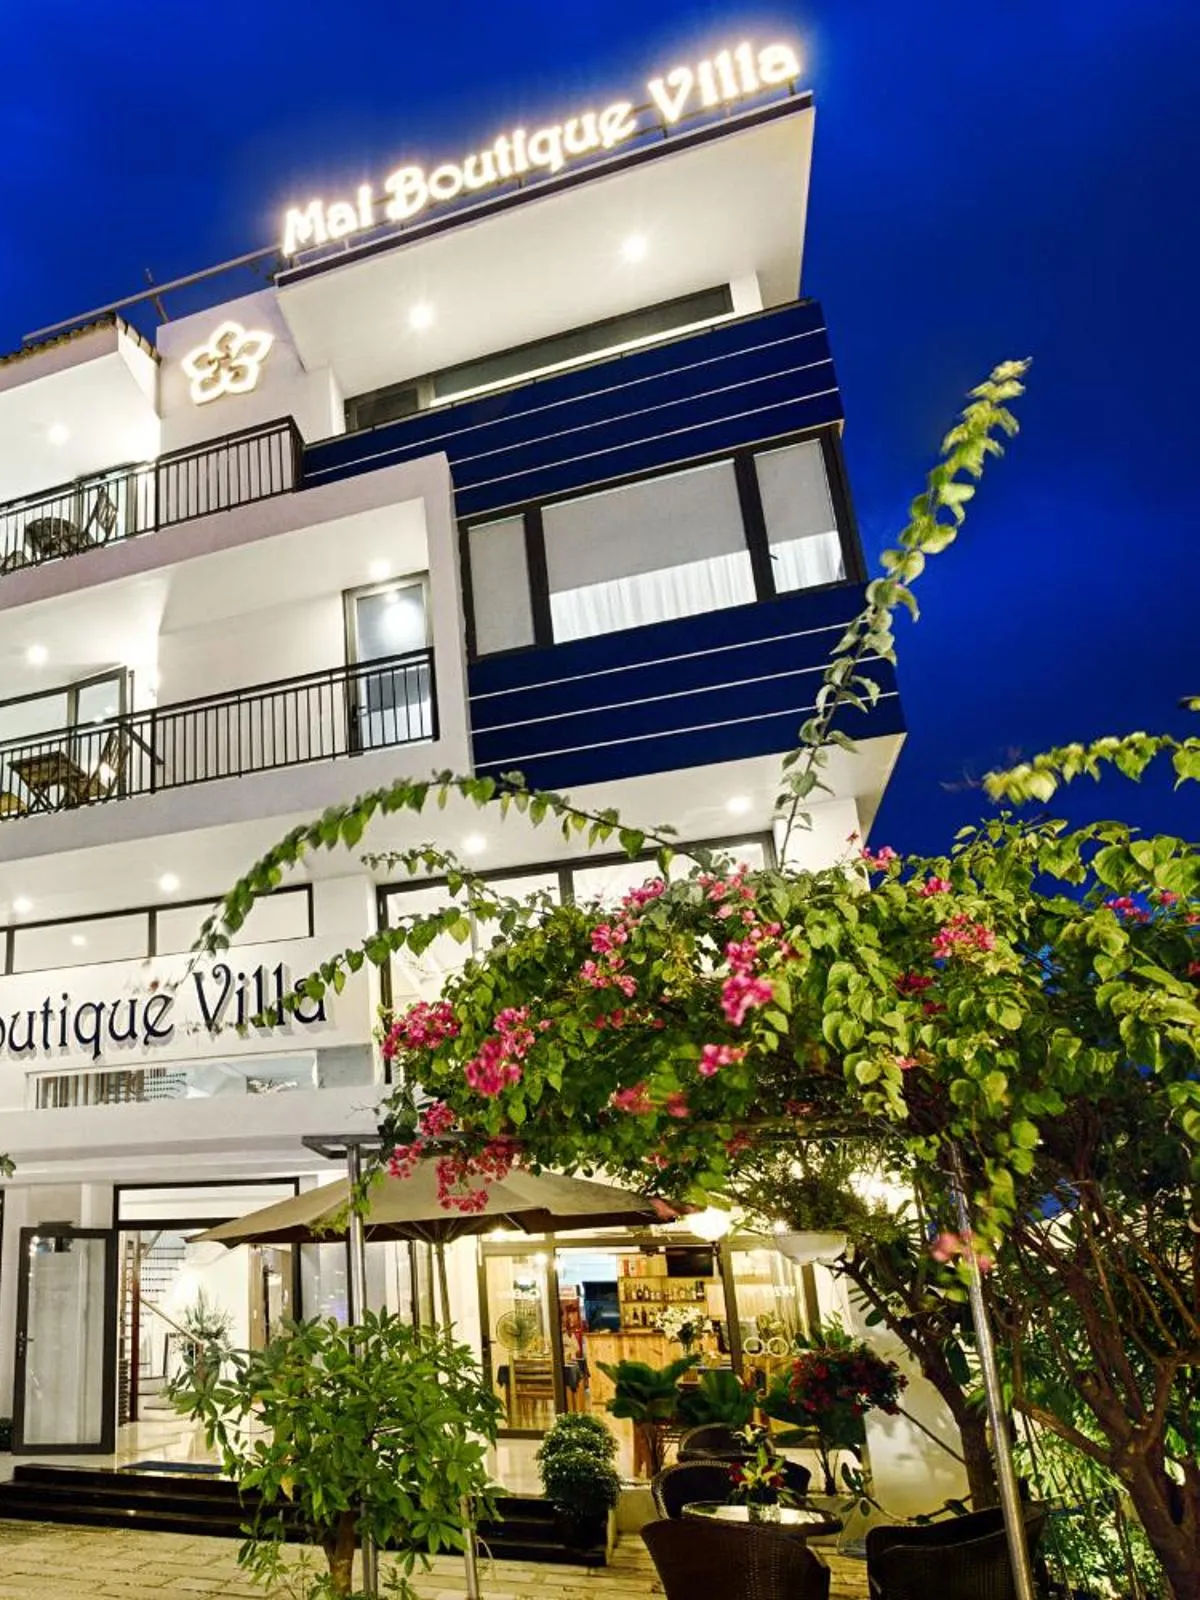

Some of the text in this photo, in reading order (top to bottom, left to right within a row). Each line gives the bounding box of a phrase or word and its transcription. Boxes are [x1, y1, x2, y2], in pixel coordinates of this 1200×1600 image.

[282, 41, 801, 256] Mai Boutique Villa
[193, 962, 327, 1033] Villa
